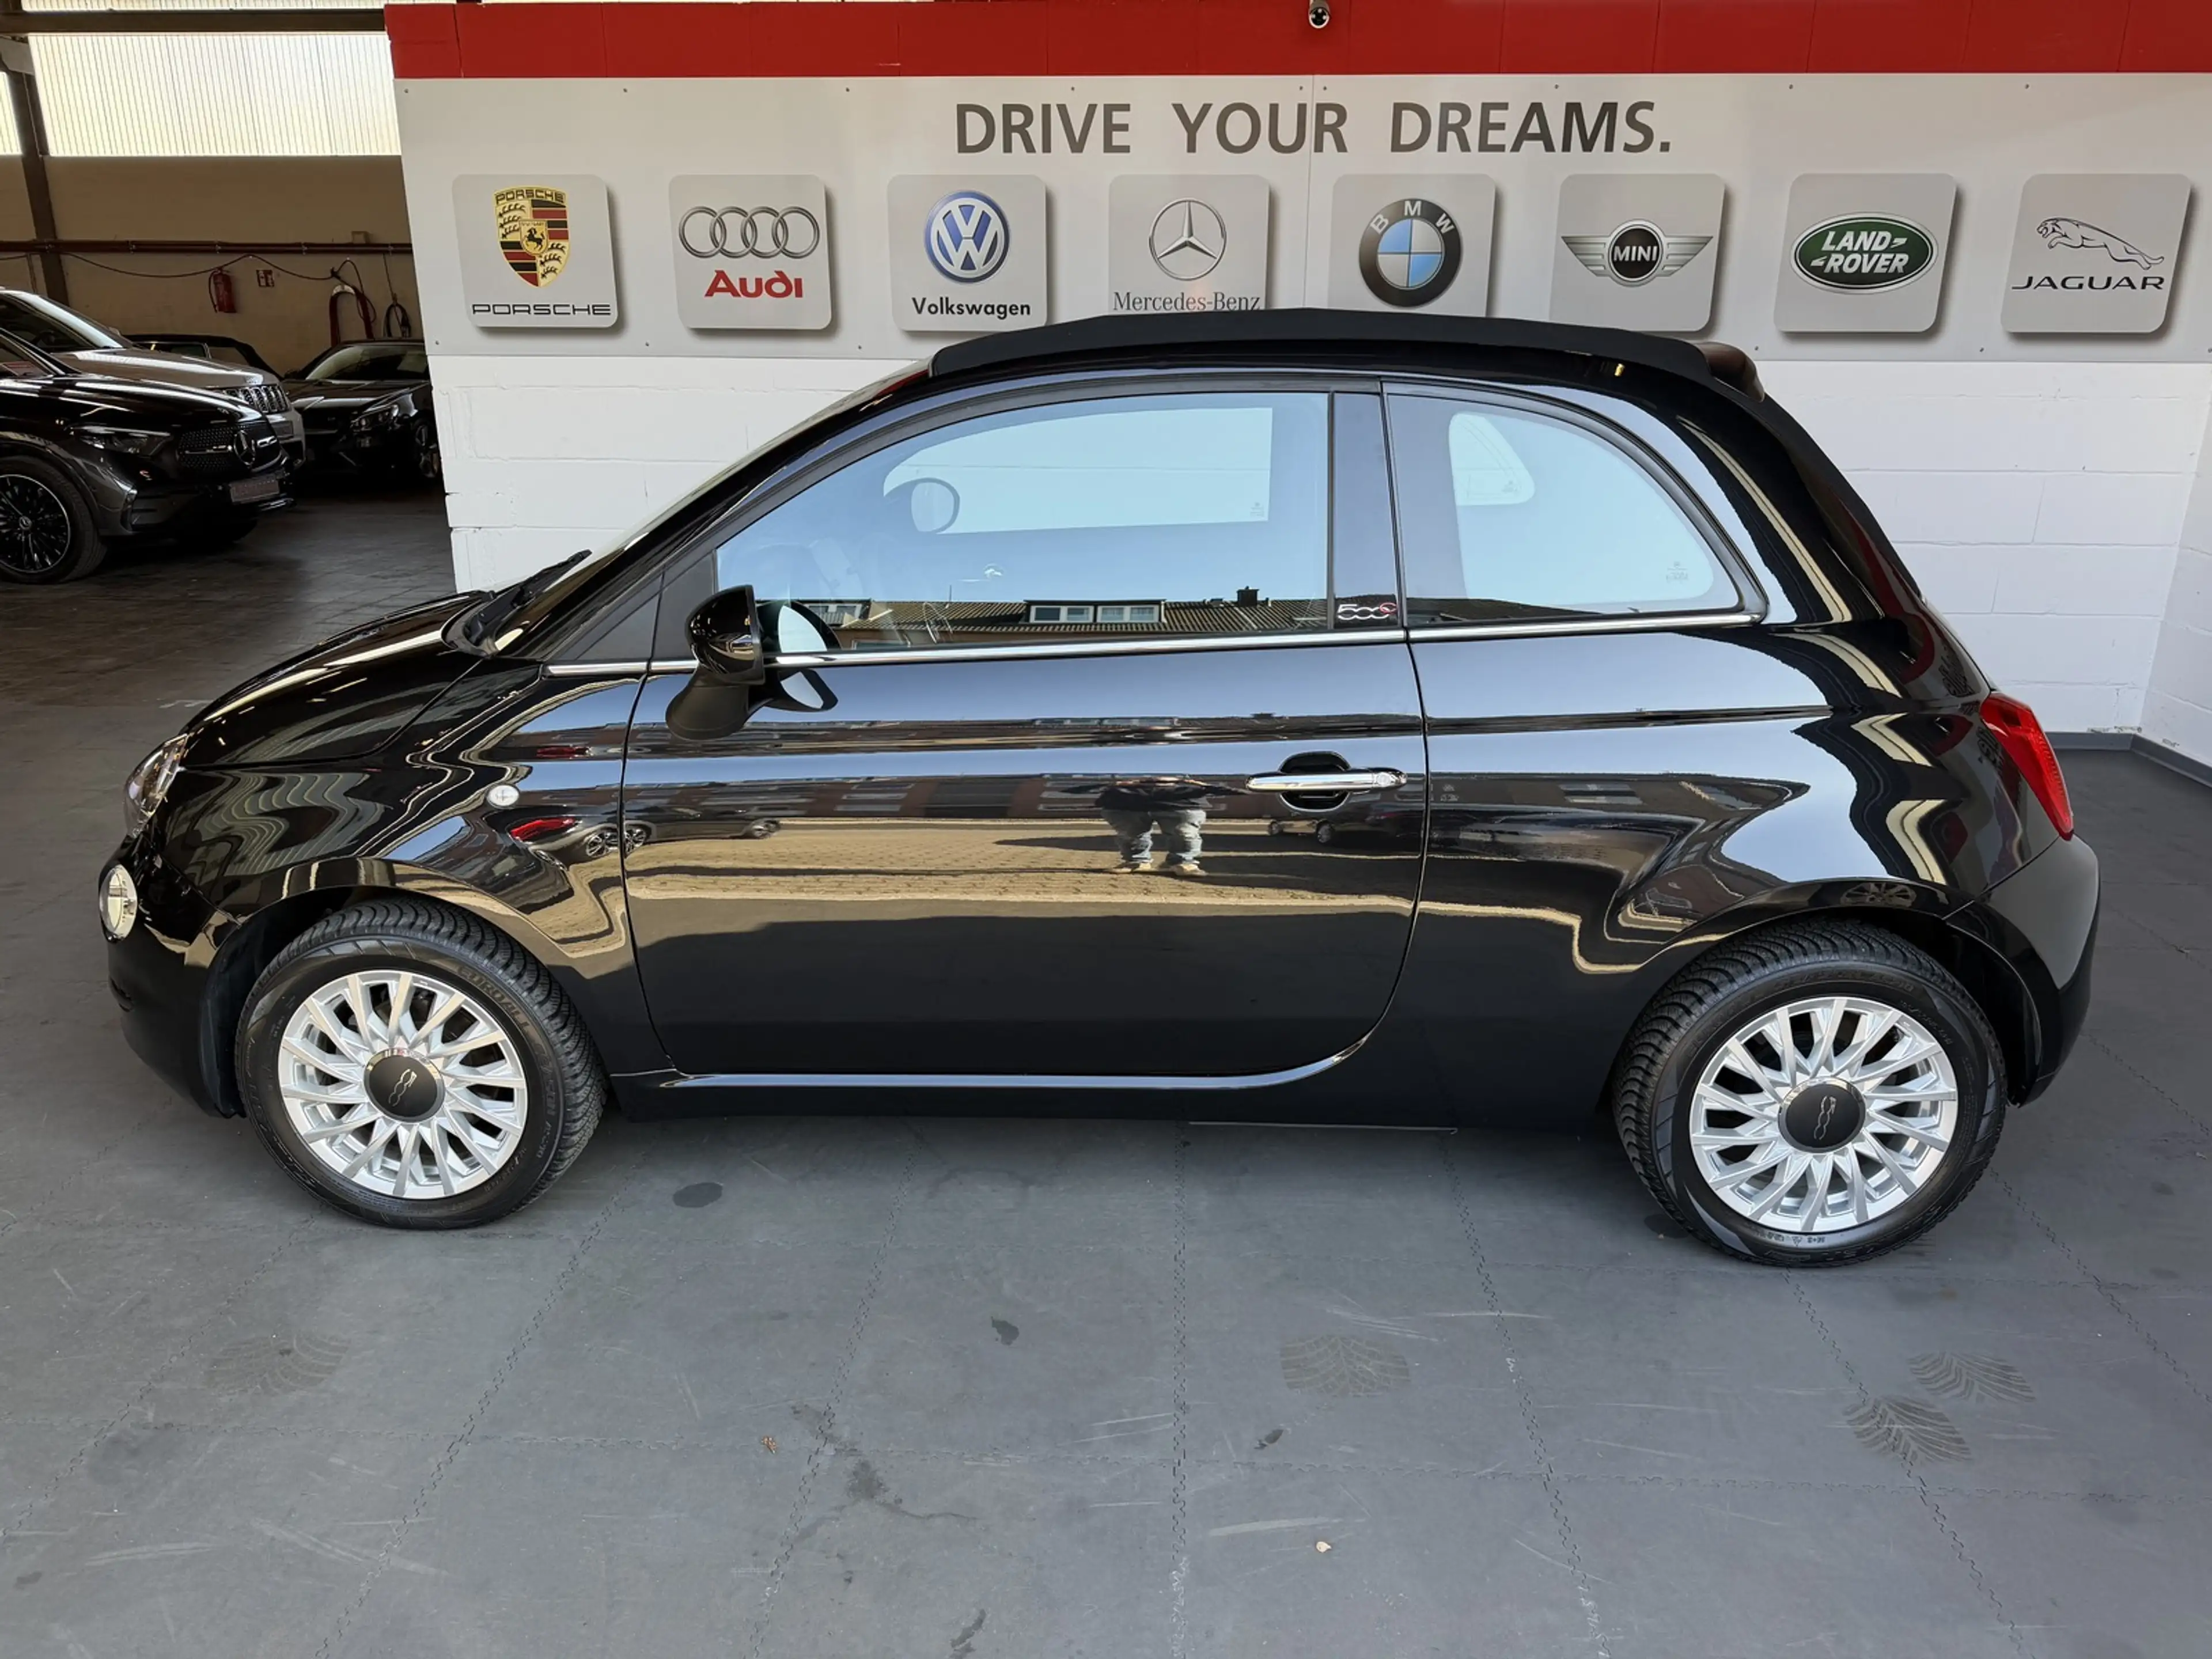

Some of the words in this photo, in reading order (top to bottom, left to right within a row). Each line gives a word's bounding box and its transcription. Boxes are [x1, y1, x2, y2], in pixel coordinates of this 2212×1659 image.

[957, 103, 1131, 154] DRIVE
[1172, 103, 1349, 154] YOUR
[1391, 101, 1671, 153] DREAMS.
[495, 189, 565, 204] PORSCHE
[1370, 200, 1455, 234] BMW
[1821, 231, 1892, 251] LAND
[1613, 245, 1658, 262] MINI
[1824, 253, 1909, 274] ROVER
[704, 270, 803, 298] Audi
[2012, 276, 2165, 290] JAGUAR
[472, 304, 611, 316] PORSCHE
[911, 297, 1031, 320] Volkswagen
[1113, 291, 1261, 311] Mercedes-Benz
